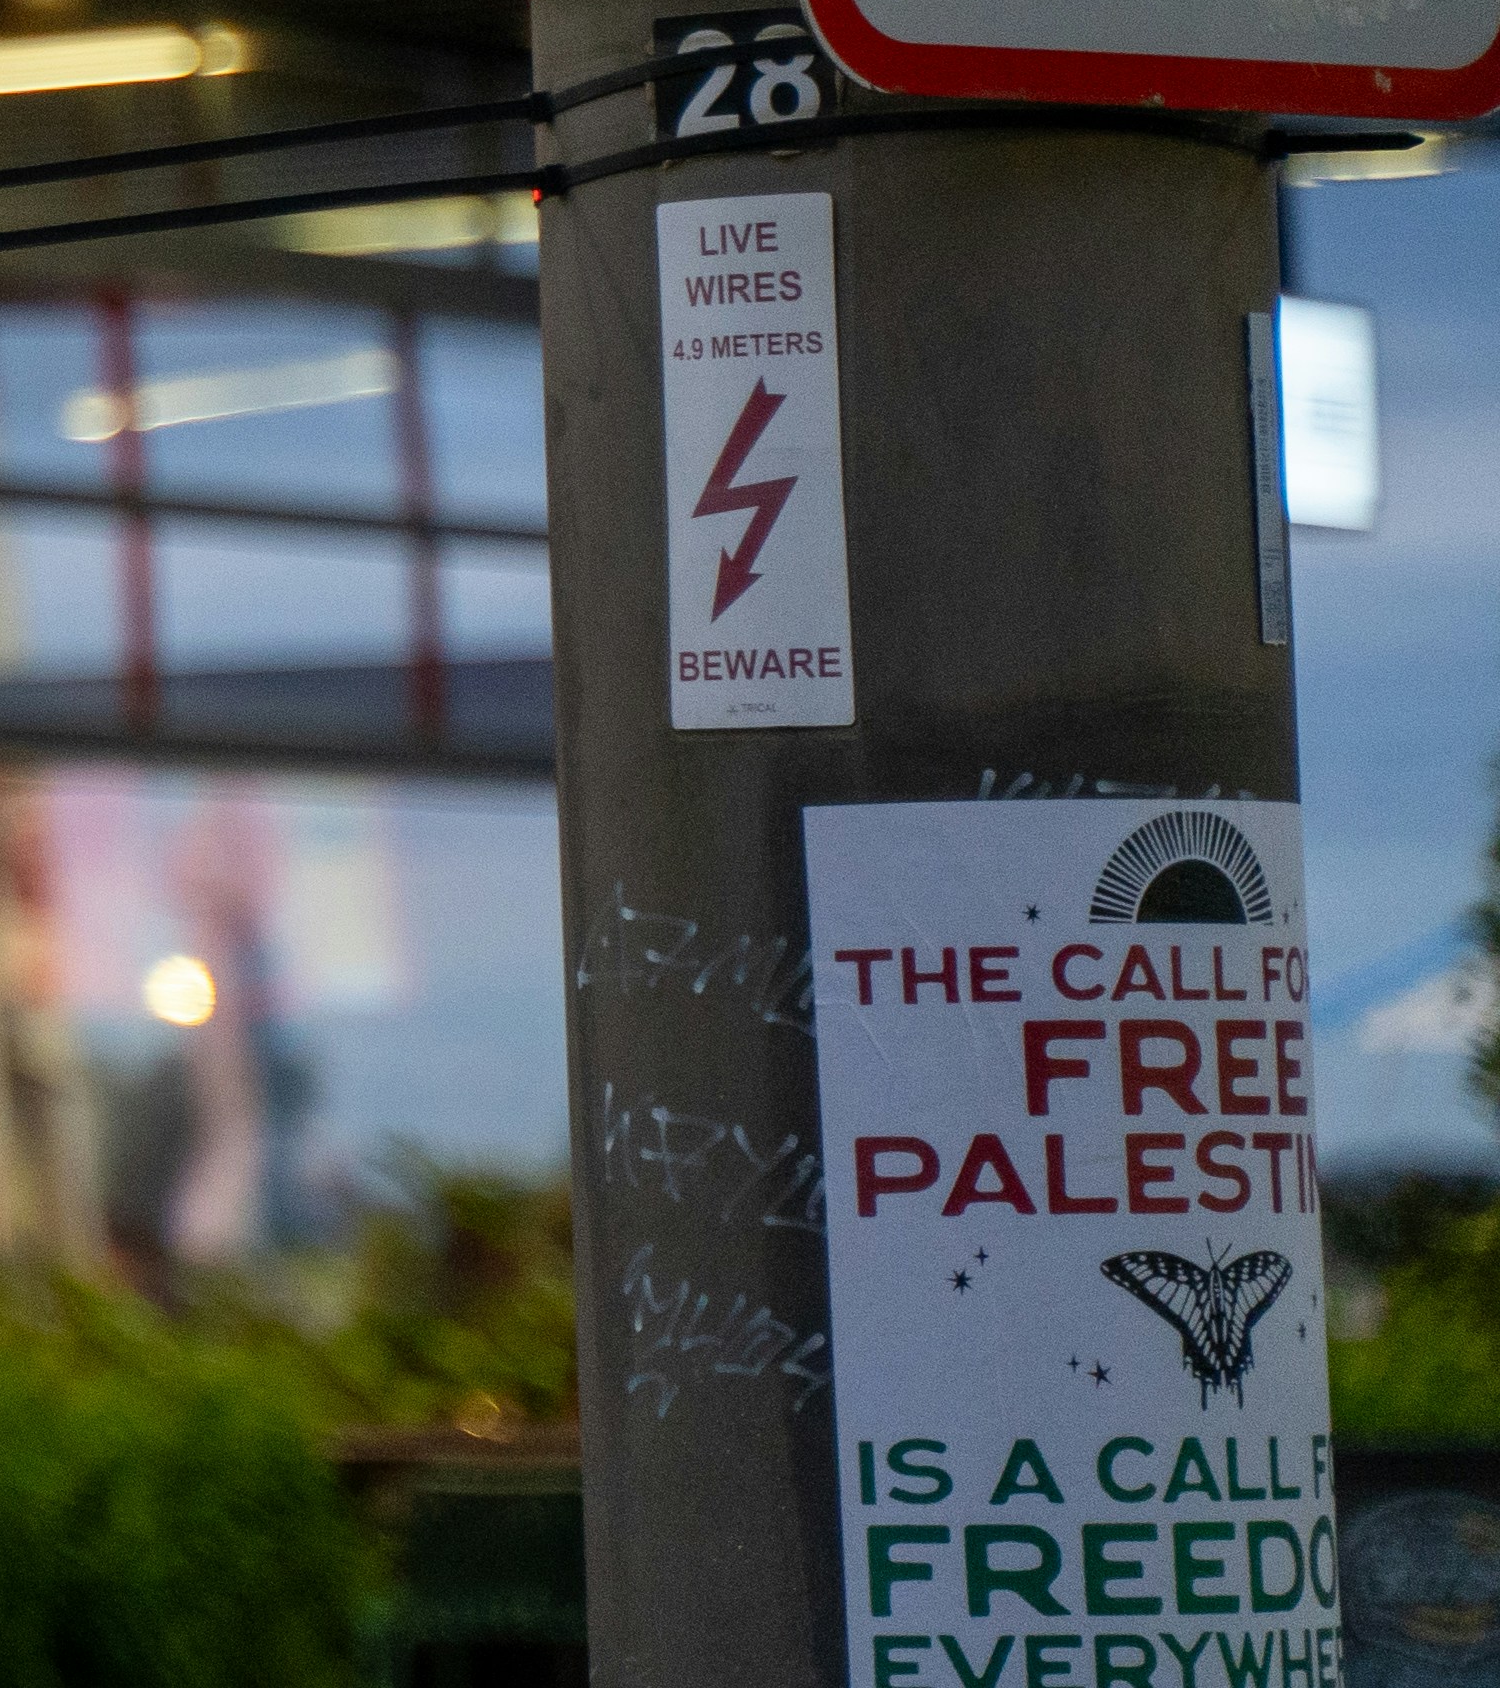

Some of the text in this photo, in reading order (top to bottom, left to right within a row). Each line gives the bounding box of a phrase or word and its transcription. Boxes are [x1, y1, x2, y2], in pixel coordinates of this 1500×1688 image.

[677, 24, 820, 139] 28
[700, 222, 779, 256] LIVE
[685, 270, 802, 307] WIRES
[673, 331, 824, 361] 4.9 METERS
[678, 646, 843, 681] BEWARE
[834, 945, 1022, 1005] THE
[1052, 944, 1248, 1002] CALL
[1022, 1019, 1308, 1116] FREE
[858, 1438, 953, 1506] IS
[989, 1438, 1065, 1505] A
[1096, 1435, 1301, 1503] CALL
